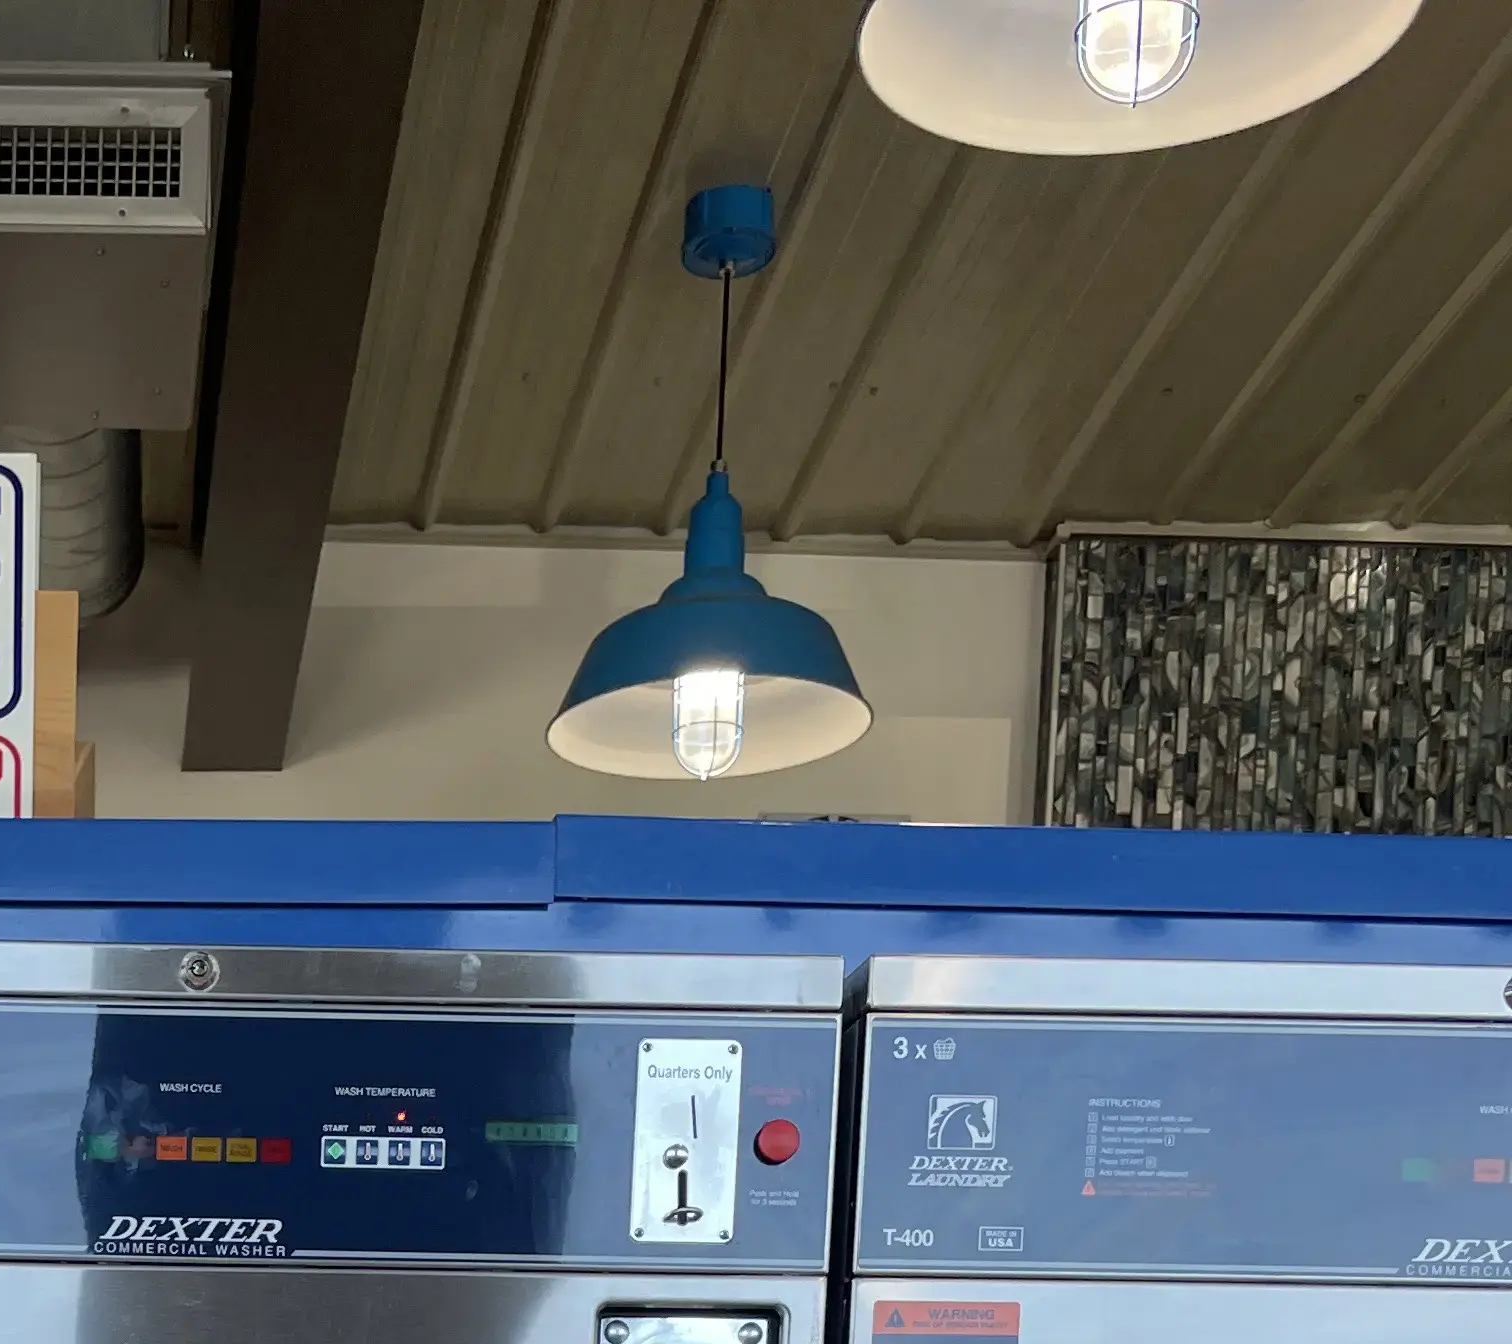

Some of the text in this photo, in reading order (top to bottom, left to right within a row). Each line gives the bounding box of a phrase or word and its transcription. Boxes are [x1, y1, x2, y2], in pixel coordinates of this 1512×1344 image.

[893, 1037, 927, 1059] 3 x
[648, 1065, 733, 1082] Quarters Only
[160, 1083, 222, 1093] WASH CYCLE
[334, 1087, 436, 1097] WASH TEMPERATURE
[1089, 1099, 1161, 1108] INSTRUCTIONS
[1480, 1106, 1508, 1114] WASH
[421, 1126, 443, 1134] COLD
[909, 1156, 1009, 1171] DEXTER
[907, 1174, 1011, 1188] LAUNDRY
[99, 1216, 283, 1243] DEXTER
[883, 1229, 934, 1247] T-400
[988, 1238, 1013, 1248] USA
[94, 1242, 286, 1256] COMMERCIAL WASHER
[1411, 1239, 1512, 1263] DEX
